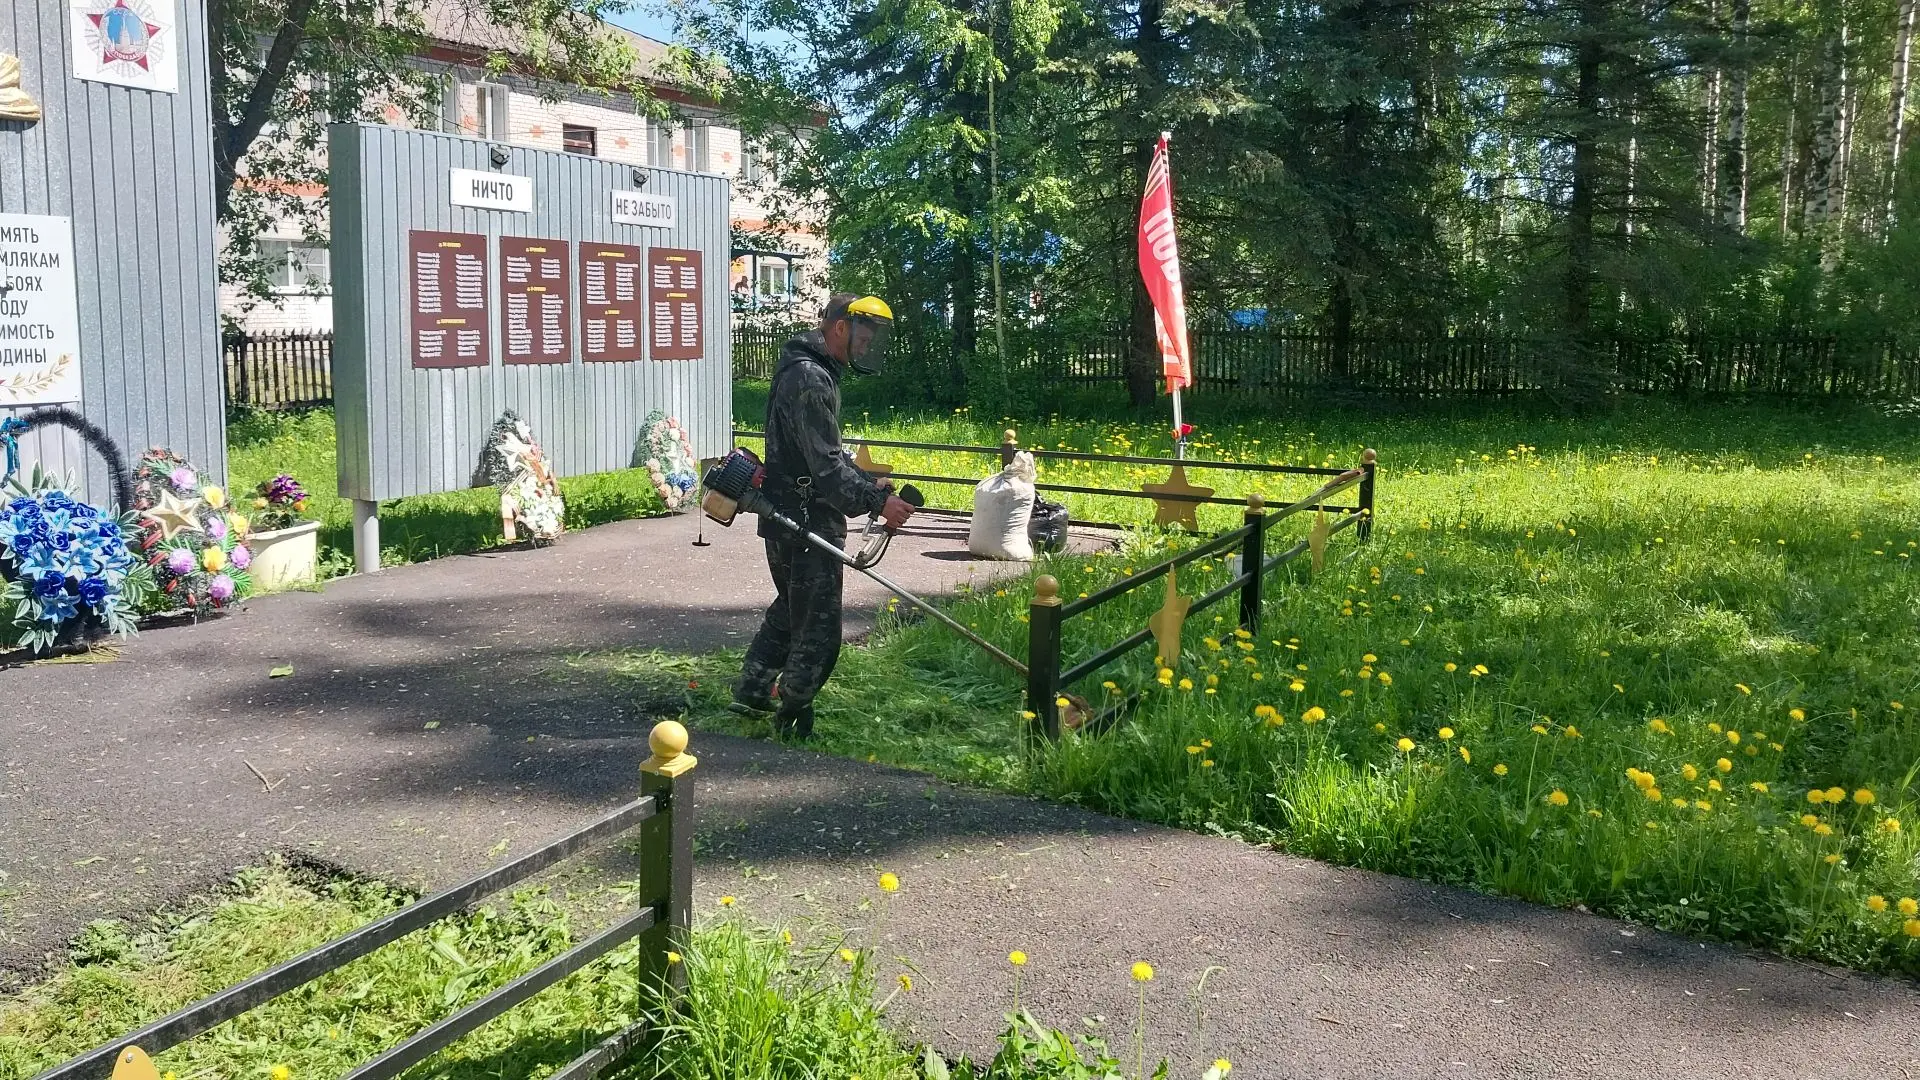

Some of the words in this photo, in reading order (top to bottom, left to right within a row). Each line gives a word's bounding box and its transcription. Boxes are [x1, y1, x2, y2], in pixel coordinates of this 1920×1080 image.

[471, 178, 514, 202] НИЧТО
[615, 197, 629, 216] НЕ
[631, 199, 672, 220] ЗАБЫТО
